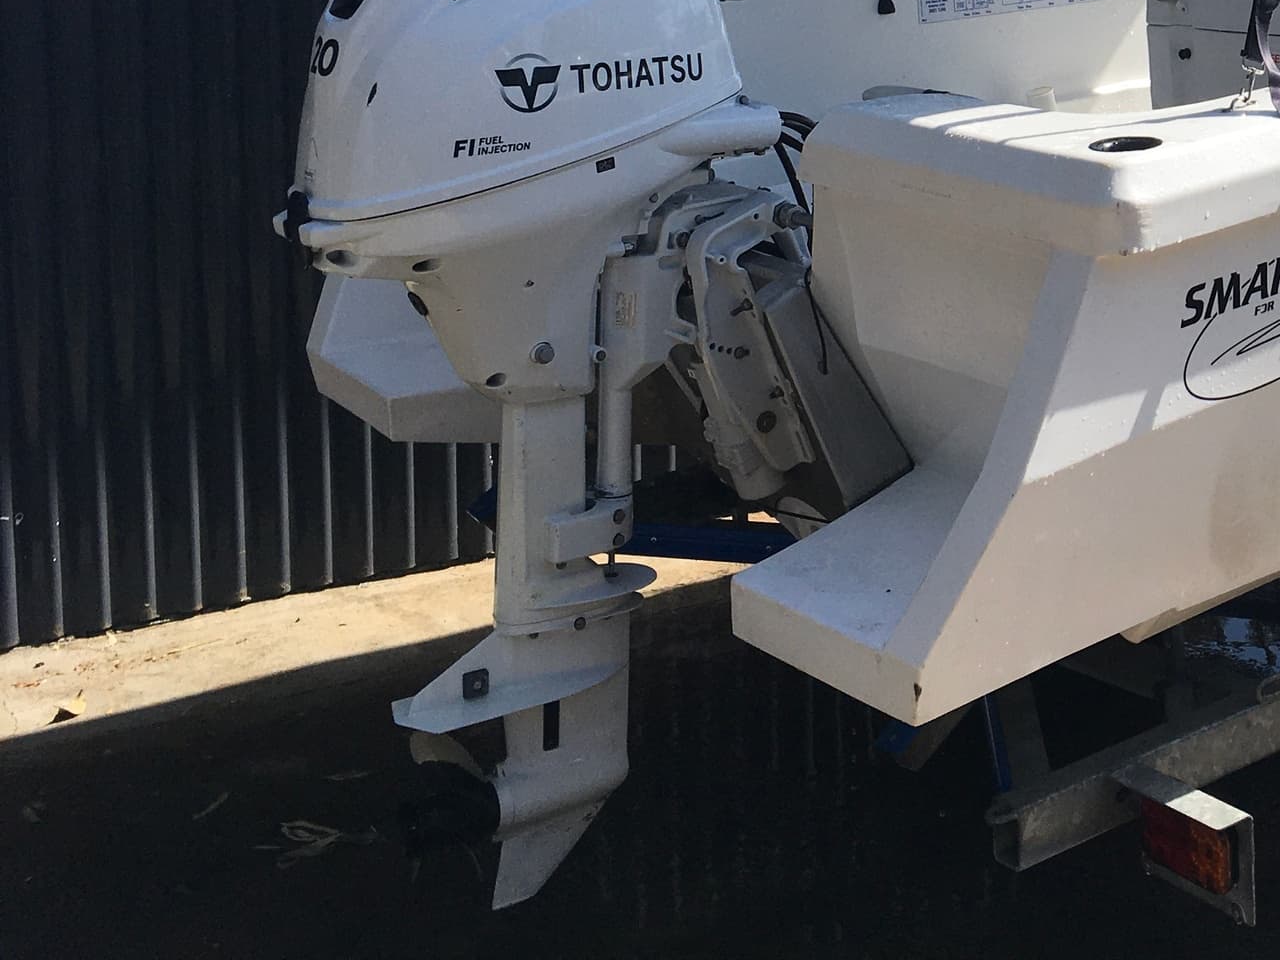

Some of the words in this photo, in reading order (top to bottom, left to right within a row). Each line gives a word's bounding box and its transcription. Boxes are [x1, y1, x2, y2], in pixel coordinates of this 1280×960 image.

[570, 53, 703, 94] TOHATSU
[453, 138, 476, 158] FI
[479, 135, 505, 145] FUEL
[477, 141, 531, 156] INJECTION
[1253, 300, 1275, 317] FOR
